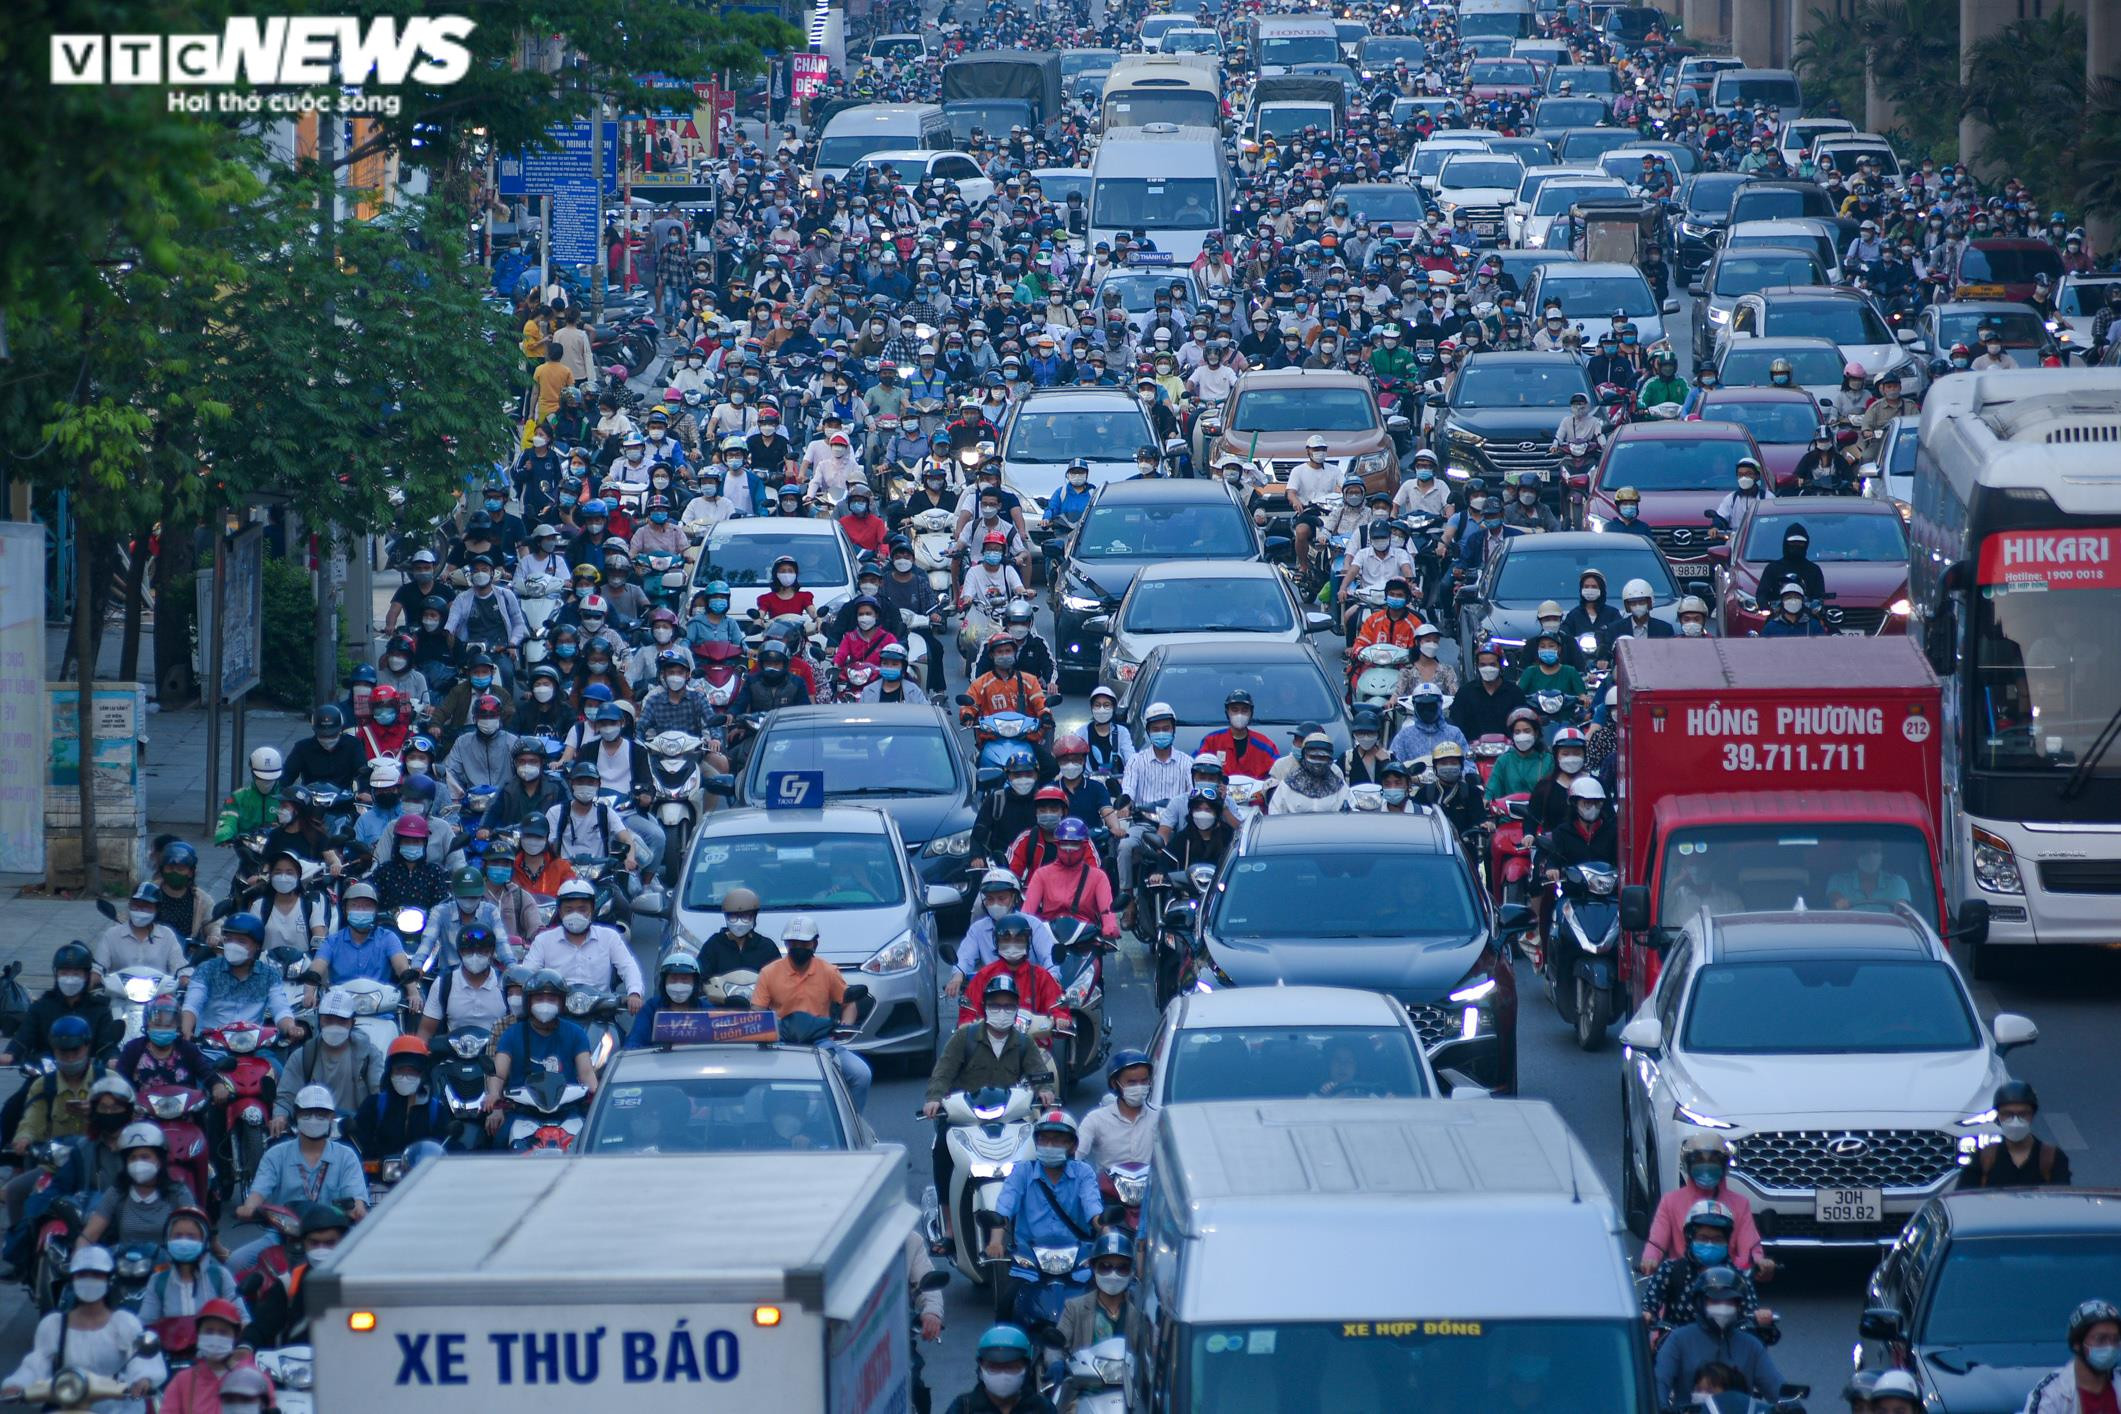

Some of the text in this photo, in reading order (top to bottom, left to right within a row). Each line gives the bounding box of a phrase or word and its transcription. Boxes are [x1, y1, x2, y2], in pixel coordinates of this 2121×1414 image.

[793, 55, 828, 74] CHĂN
[566, 139, 587, 148] MINH
[2003, 536, 2109, 566] HIKARI
[2005, 570, 2104, 583] Hotline: 1900 0018
[1652, 700, 1928, 736] VT HỒNG PHƯƠNG 212
[1722, 743, 1866, 771] 39.711.711
[779, 774, 811, 804] G7
[733, 1013, 761, 1025] Luôn
[713, 1027, 742, 1041] Luôn
[1835, 1191, 1863, 1205] 30H
[1823, 1206, 1874, 1220] 509.82
[1342, 1319, 1481, 1339] XE HỢP ĐỒNG
[395, 1318, 741, 1386] XE THƯ BÁO
